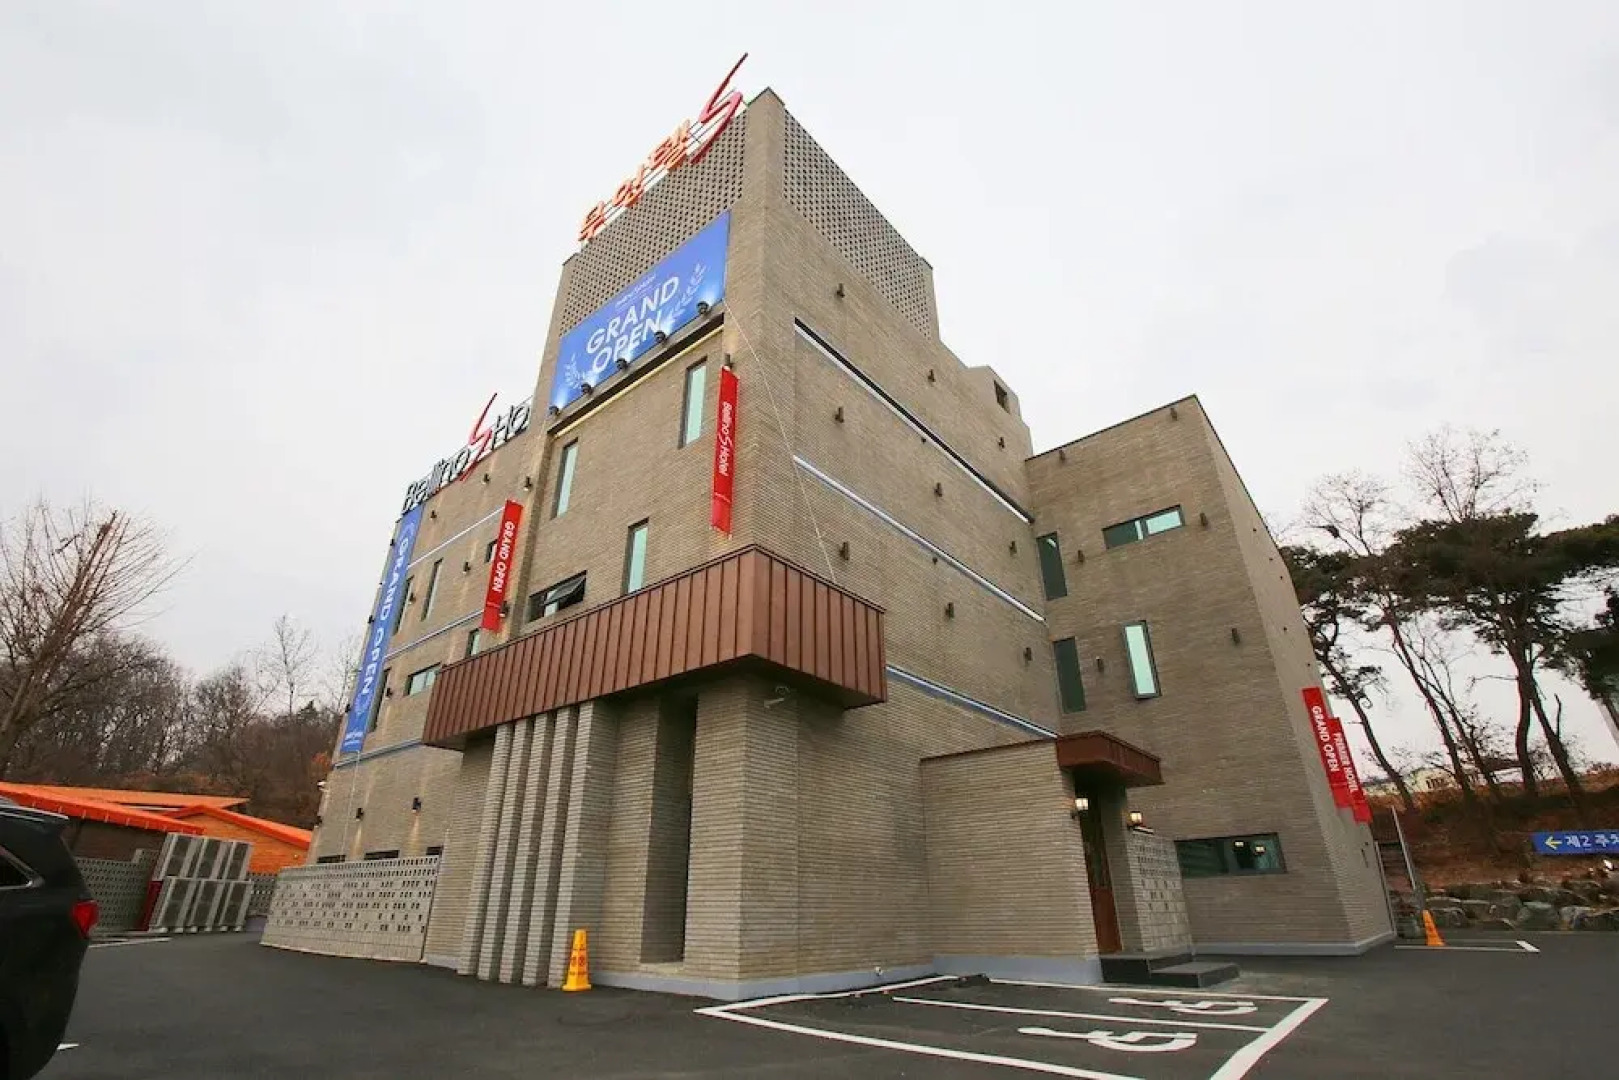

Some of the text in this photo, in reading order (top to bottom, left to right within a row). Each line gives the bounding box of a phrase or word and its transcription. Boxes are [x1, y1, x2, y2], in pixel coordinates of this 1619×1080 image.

[587, 277, 679, 354] GRAND
[594, 312, 662, 373] OPEN
[492, 521, 516, 593] GRAND OPEN
[361, 536, 409, 696] GRAND OPEN
[1312, 705, 1340, 773] GRAND OPEN
[1564, 834, 1592, 848] 제2
